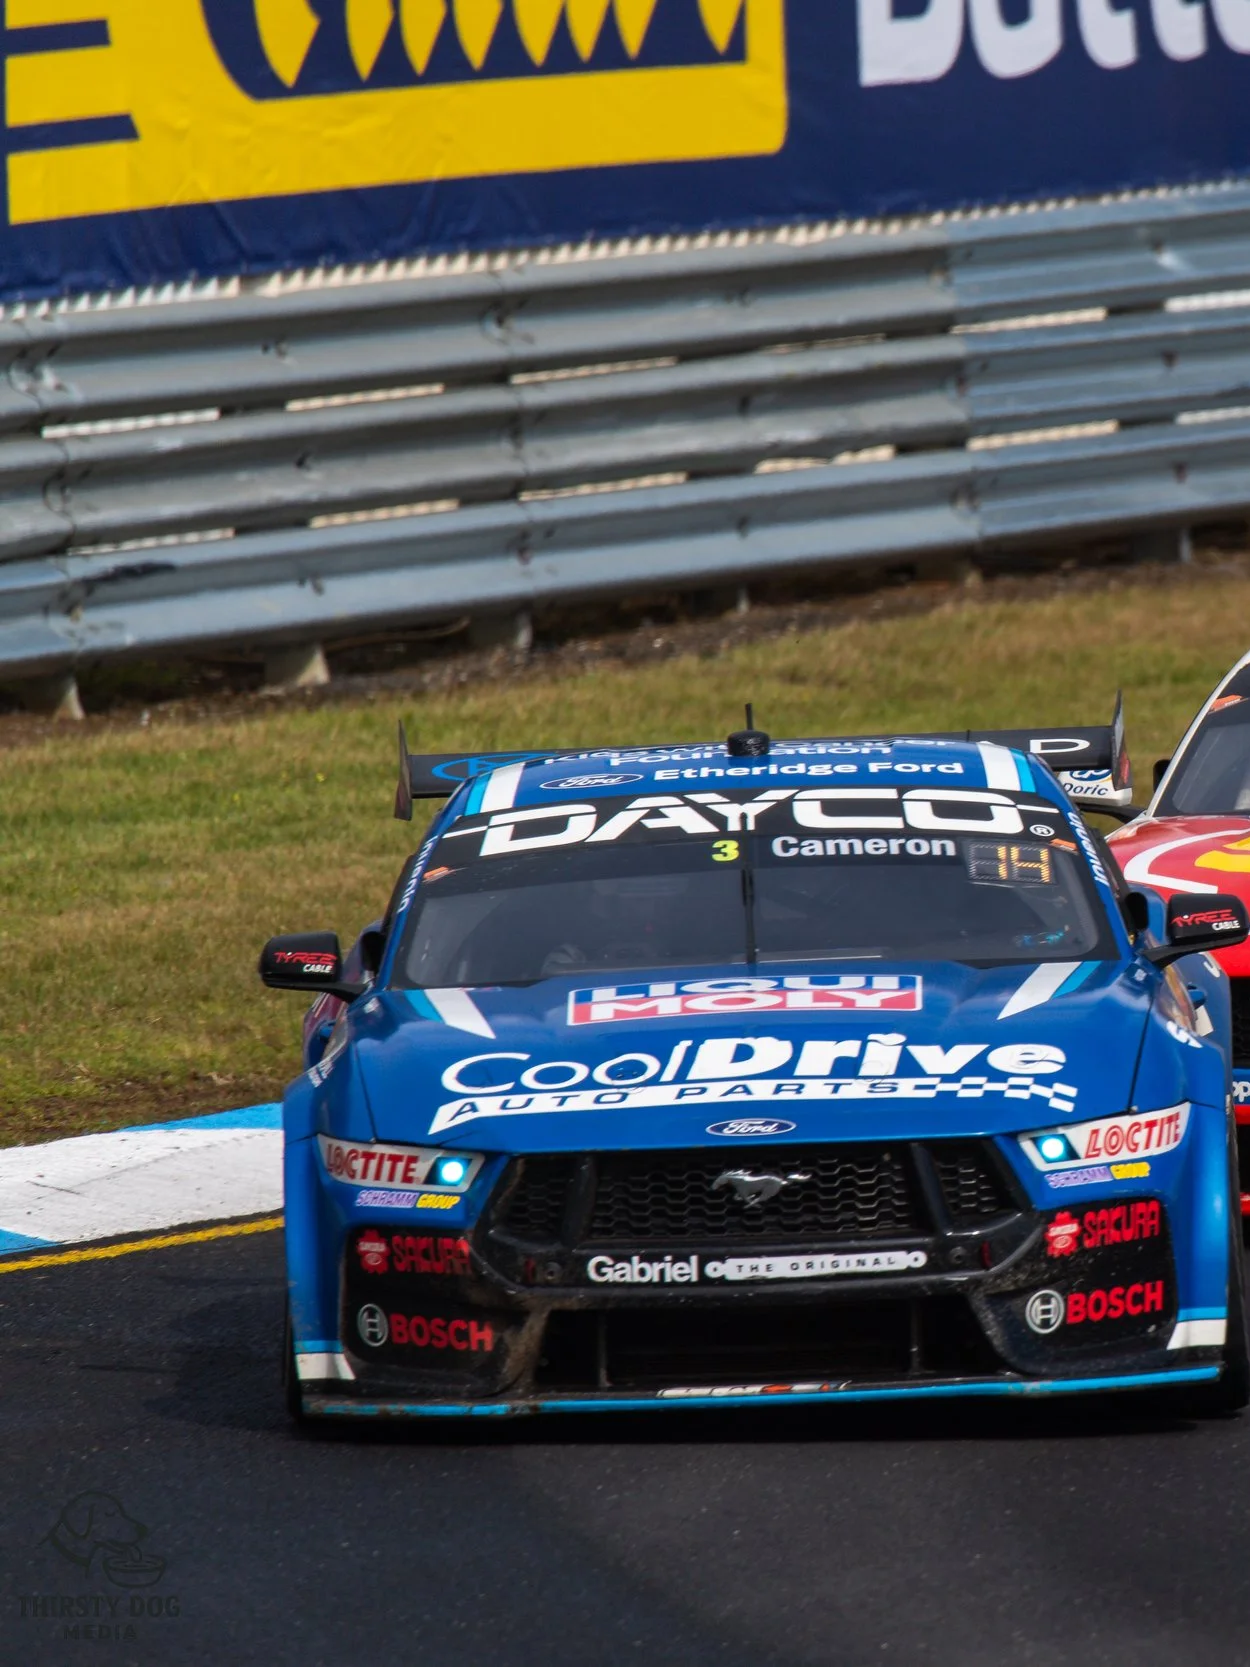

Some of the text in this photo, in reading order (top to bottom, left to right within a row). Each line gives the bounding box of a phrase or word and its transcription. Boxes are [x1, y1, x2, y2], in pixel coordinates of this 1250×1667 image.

[610, 746, 891, 766] Founation
[558, 774, 624, 787] Ford
[654, 762, 965, 780] Etheridge Ford
[478, 787, 1024, 857] DAYCO
[711, 840, 740, 862] 3
[772, 836, 956, 858] Cameron
[1212, 920, 1240, 930] CABLE
[303, 964, 333, 974] CABLE
[592, 976, 901, 1002] LIQUI
[590, 990, 911, 1021] MOLY
[441, 1032, 1066, 1095] CoolDrive
[447, 1081, 900, 1122] AUTO PARTS
[722, 1119, 779, 1135] Ford
[1085, 1111, 1180, 1159] LOCTITE
[326, 1143, 420, 1184] LOCTITE
[416, 1193, 460, 1209] GROUP
[586, 1255, 699, 1283] Gabriel
[737, 1256, 896, 1273] THE ORIGINAL
[1066, 1280, 1164, 1324] BOSCH
[389, 1314, 495, 1352] BOSCH
